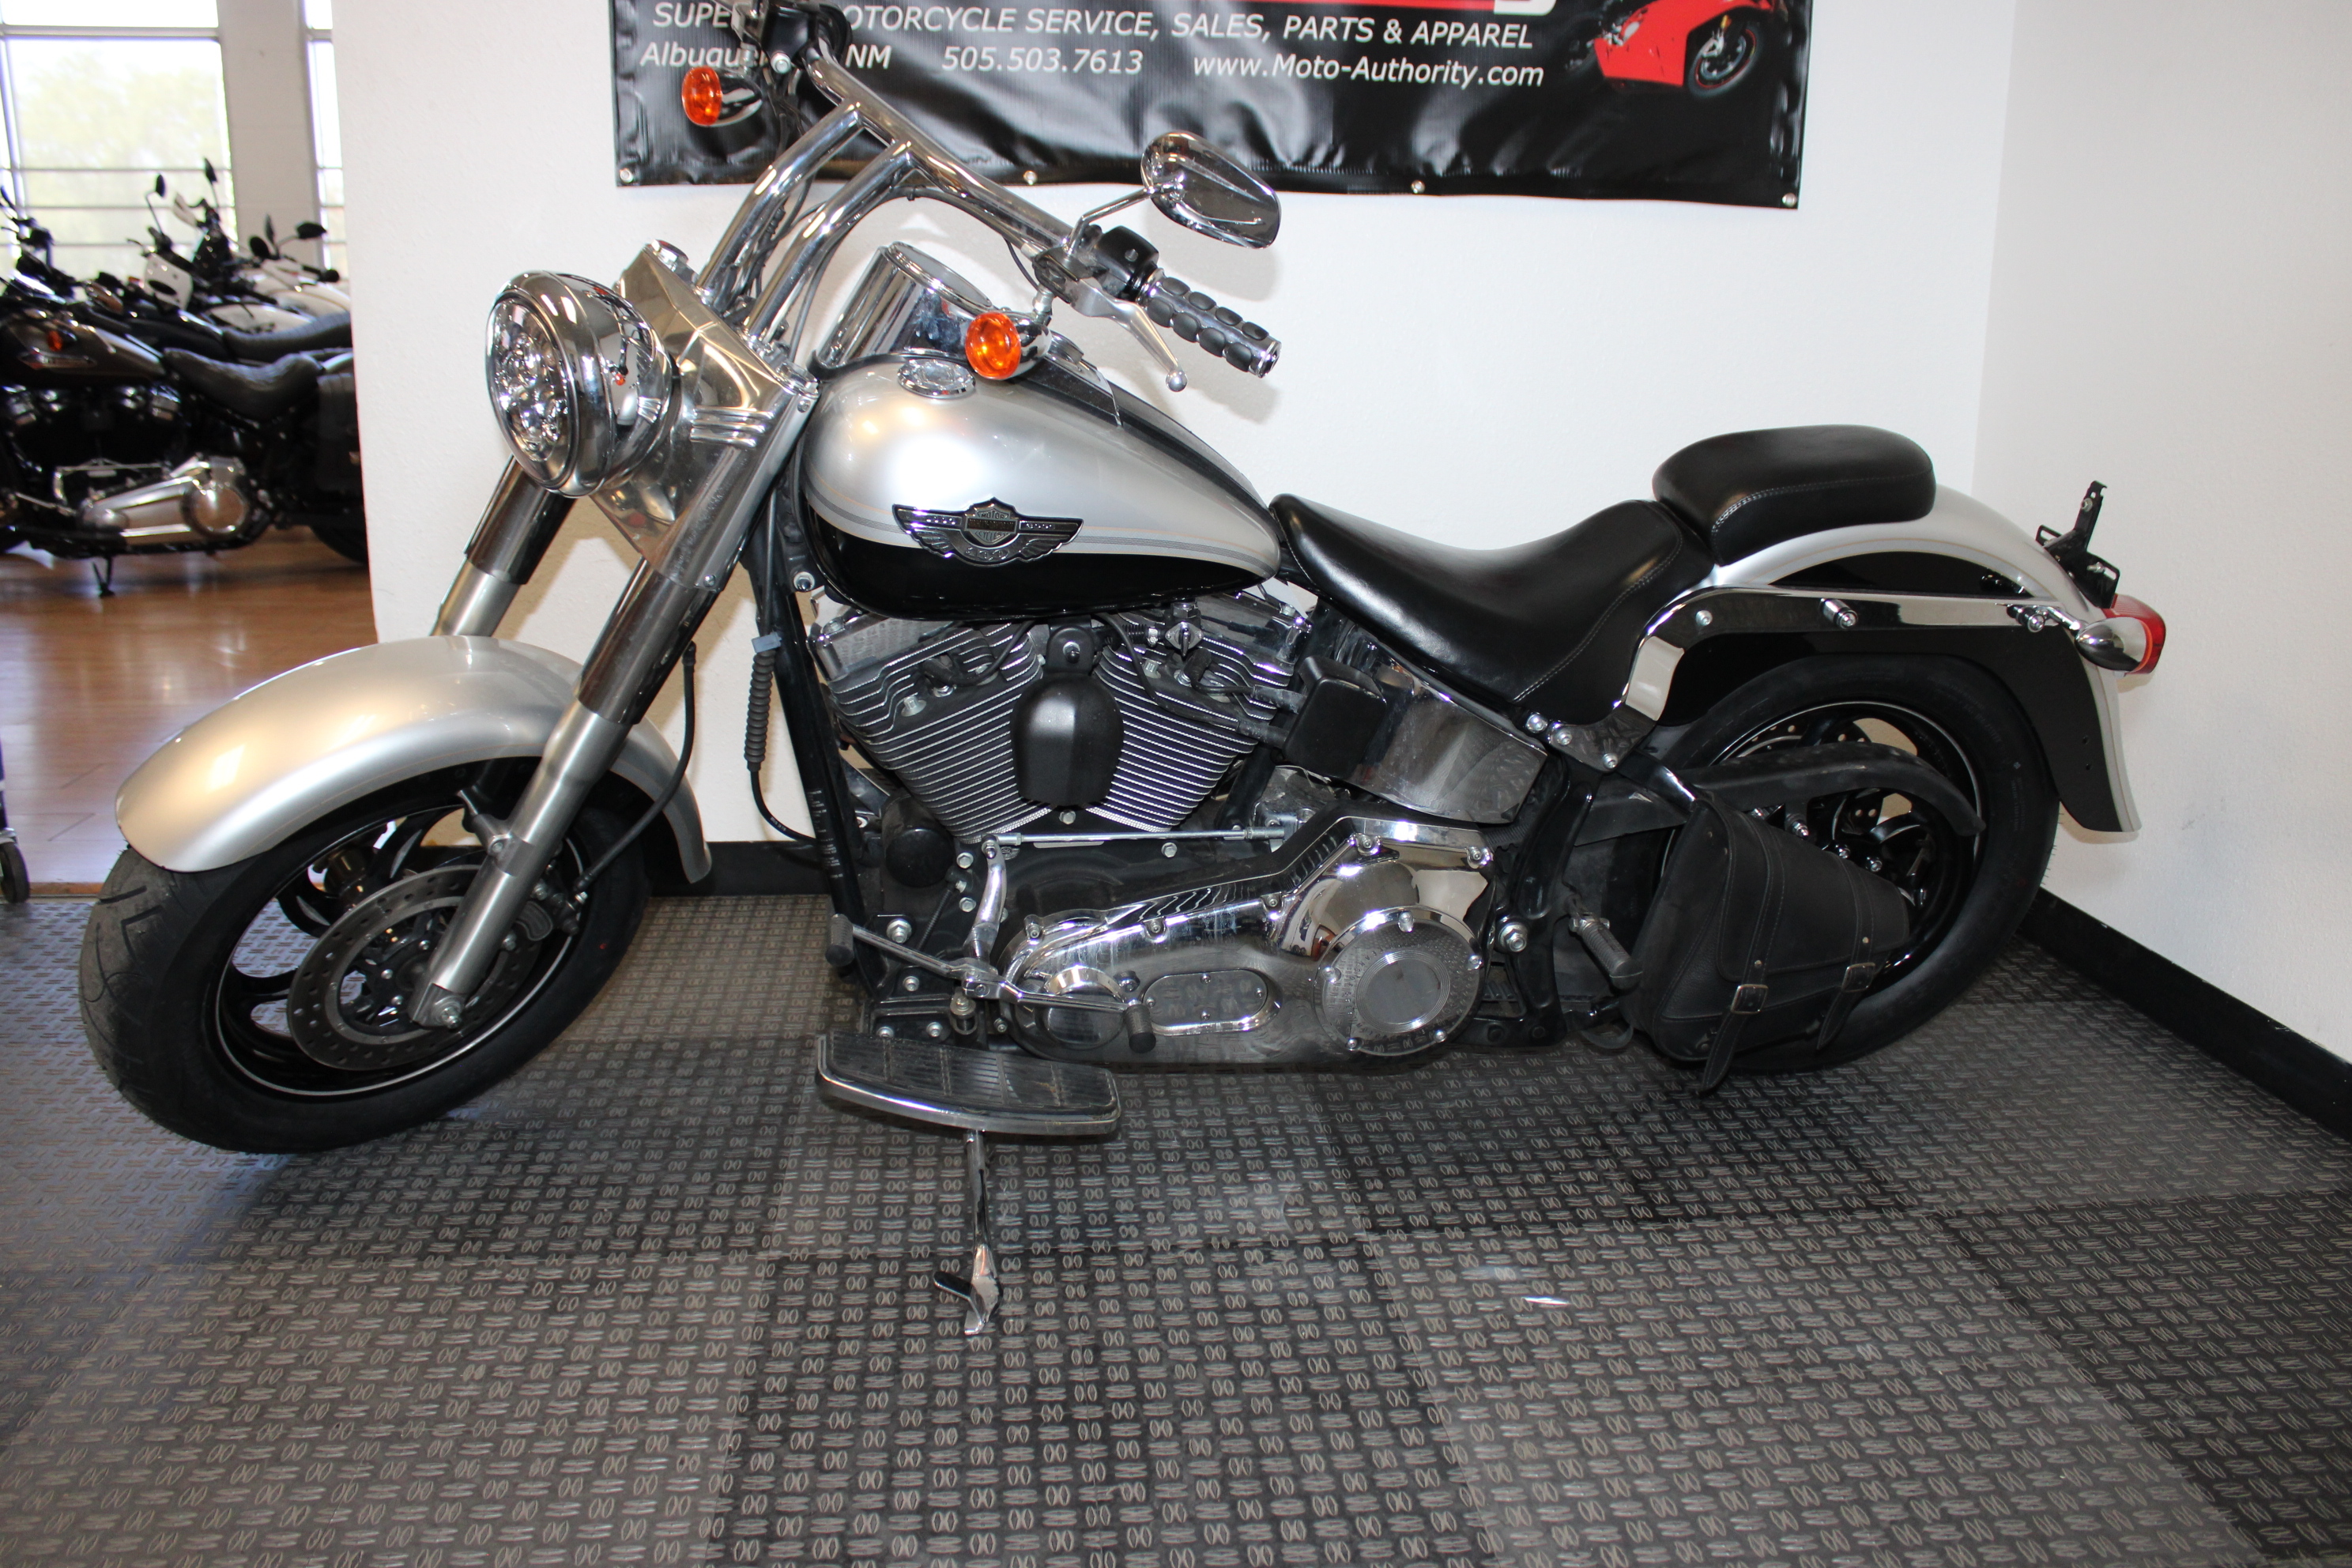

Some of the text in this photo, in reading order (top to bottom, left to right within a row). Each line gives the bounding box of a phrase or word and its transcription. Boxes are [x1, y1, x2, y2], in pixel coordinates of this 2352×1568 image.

[653, 2, 1533, 48] SUPE OTORCYCLE SERVICE, SALES, PARTS & APPAREL
[639, 42, 1544, 90] Albuqu NM 505.503.7613 www.Moto-Authority.com
[981, 511, 1004, 520] MOTOR
